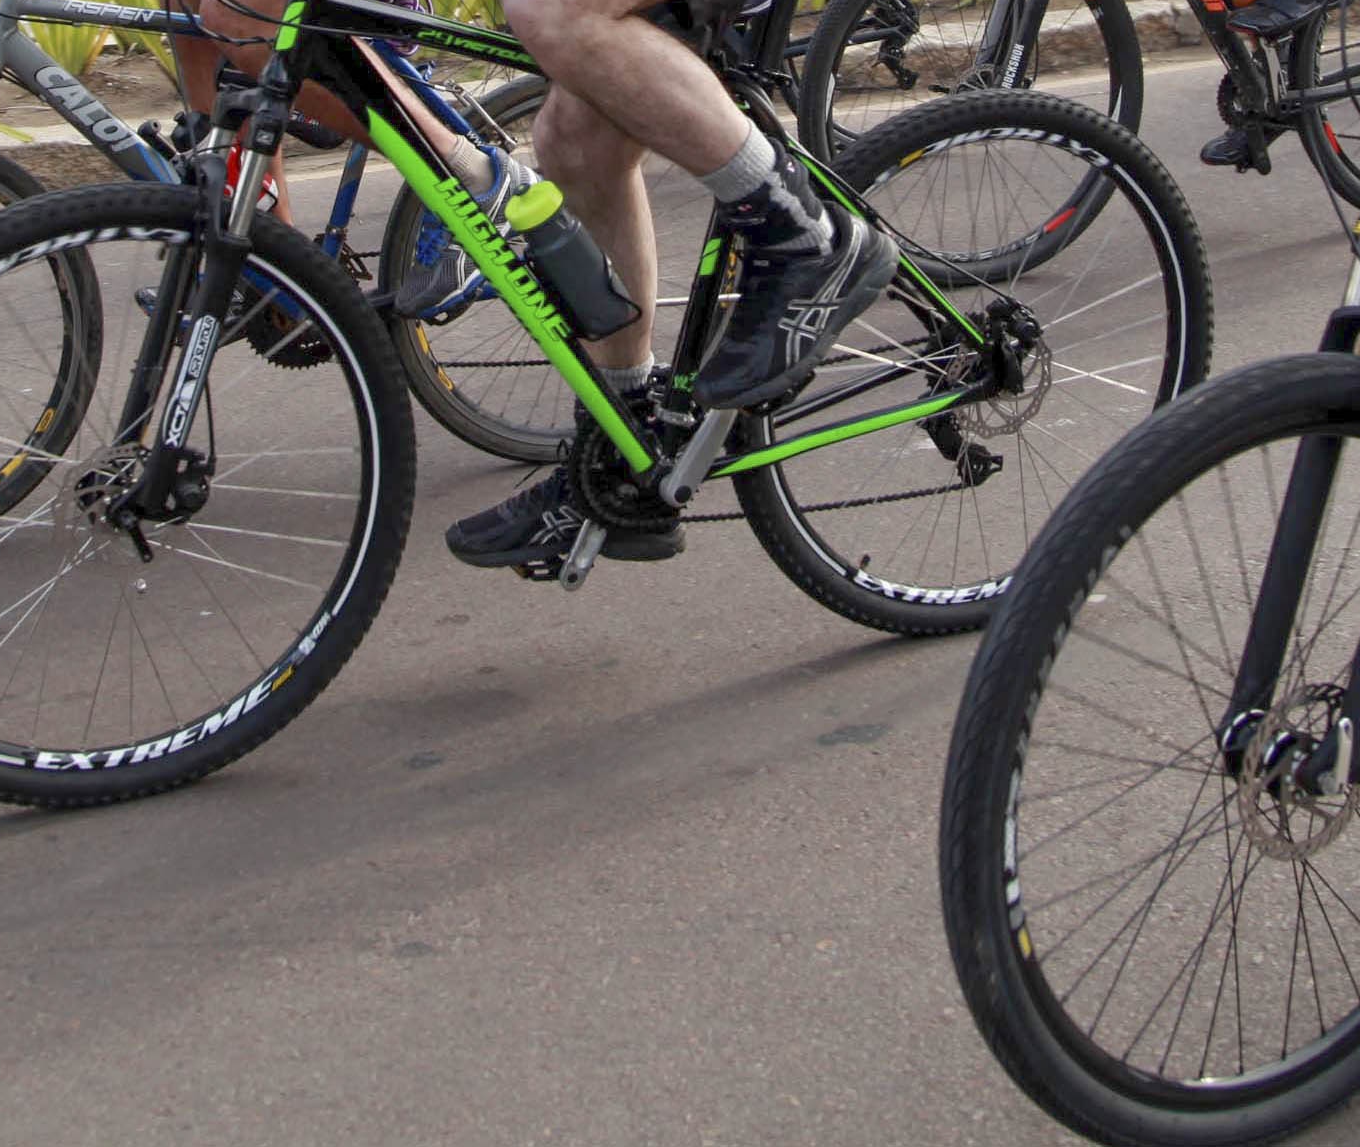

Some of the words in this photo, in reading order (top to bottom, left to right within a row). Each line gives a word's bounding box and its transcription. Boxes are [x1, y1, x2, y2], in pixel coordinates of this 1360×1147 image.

[35, 65, 139, 153] CALOI
[1001, 43, 1025, 89] ROCKSHOX
[435, 177, 520, 268] HIGH
[503, 266, 574, 343] ONE
[853, 568, 1015, 605] EXTREM
[34, 667, 280, 771] EXTREME
